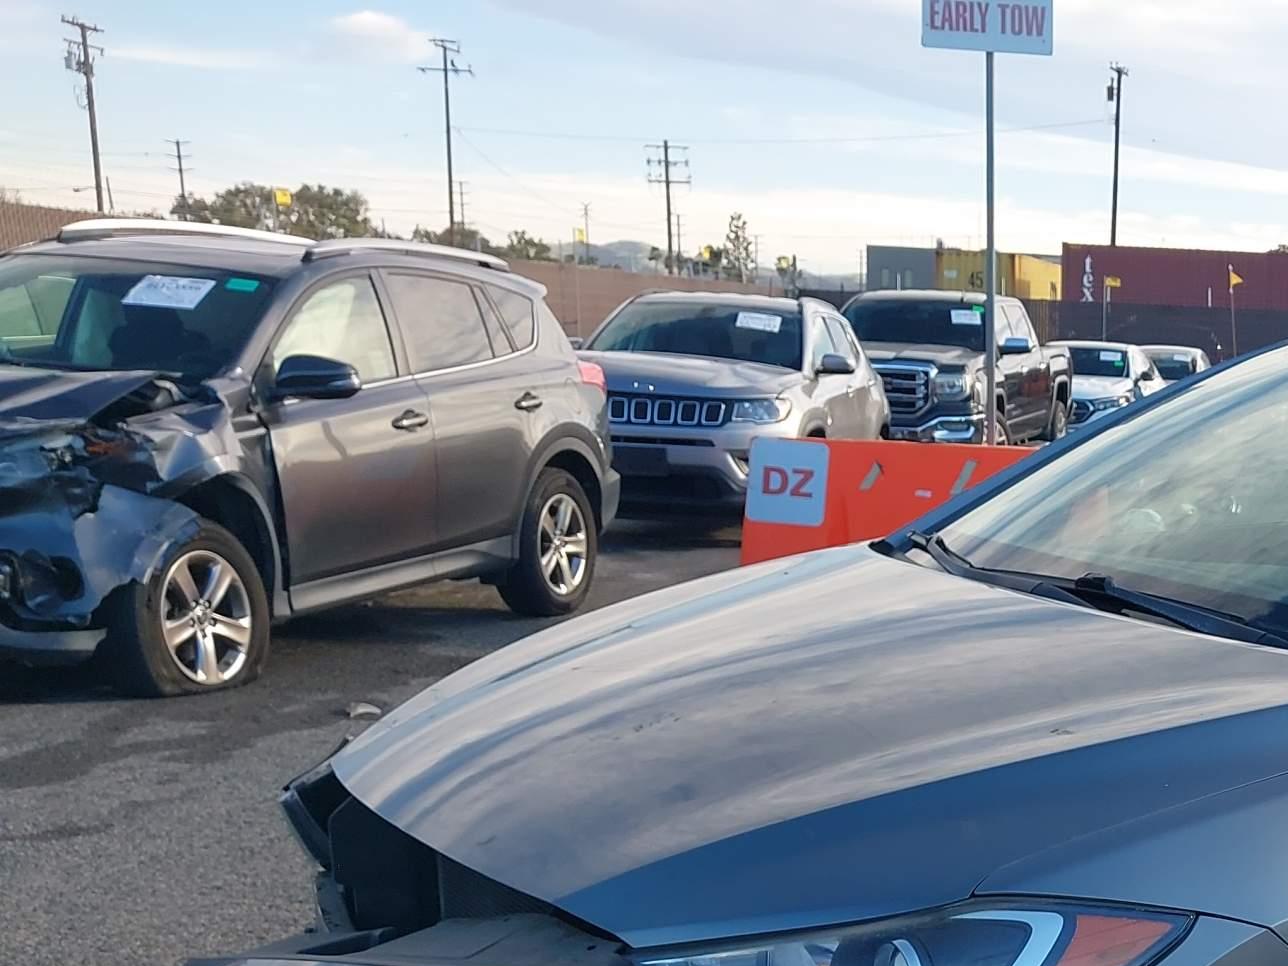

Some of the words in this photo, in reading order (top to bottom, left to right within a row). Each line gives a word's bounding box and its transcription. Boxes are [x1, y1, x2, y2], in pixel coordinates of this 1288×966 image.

[929, 0, 990, 33] EARLY
[997, 3, 1046, 37] TOW
[968, 271, 984, 289] 45
[761, 465, 815, 498] DZ
